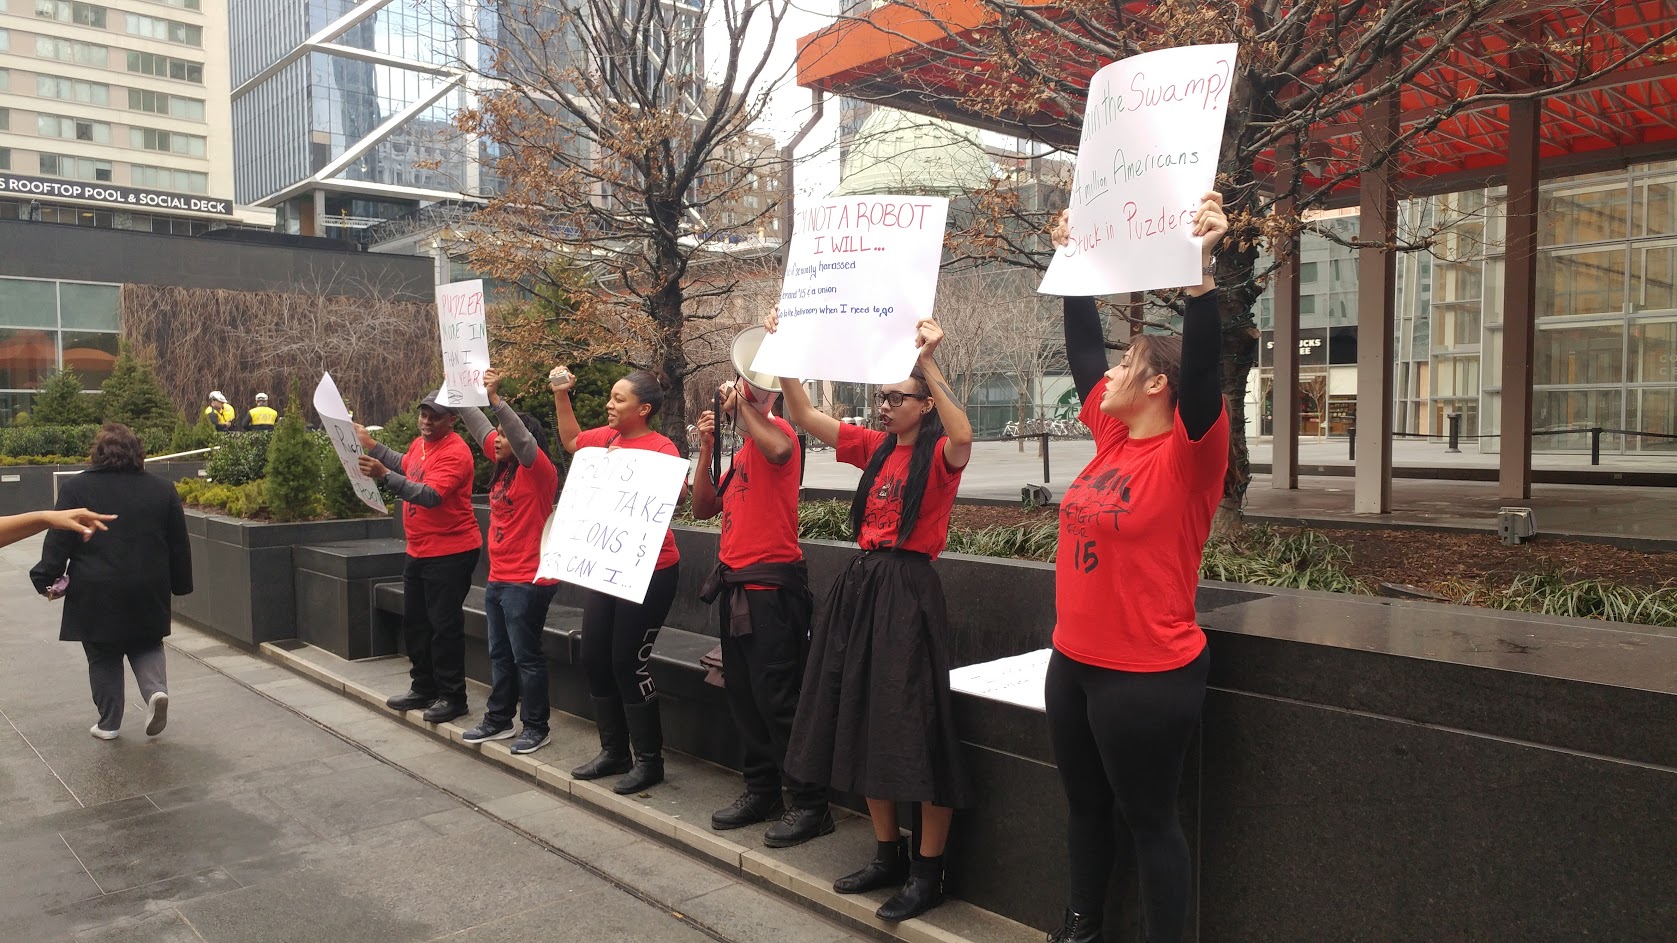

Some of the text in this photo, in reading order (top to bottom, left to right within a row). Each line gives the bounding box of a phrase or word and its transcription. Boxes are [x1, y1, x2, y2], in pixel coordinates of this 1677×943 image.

[1102, 80, 1125, 125] the
[1128, 59, 1230, 111] Swamp?
[1085, 170, 1108, 199] million
[1114, 149, 1199, 184] Americans
[9, 179, 82, 197] ROOFTOP
[85, 187, 125, 202] POOL
[128, 193, 137, 203] &
[140, 193, 188, 209] SOCIAL
[190, 199, 225, 213] DECK
[807, 205, 837, 232] NOT
[838, 205, 849, 230] A
[856, 202, 932, 232] ROBOT
[814, 236, 825, 255] I
[1064, 224, 1101, 257] Stuck
[1106, 223, 1115, 240] in
[819, 260, 856, 272] harassed
[817, 286, 837, 295] union
[819, 305, 838, 314] when
[840, 303, 848, 313] I
[850, 306, 870, 314] need
[873, 305, 880, 314] to
[879, 306, 894, 317] go
[461, 350, 472, 365] I
[614, 490, 674, 523] TAKE
[567, 555, 597, 578] CAN
[1075, 540, 1099, 574] 15
